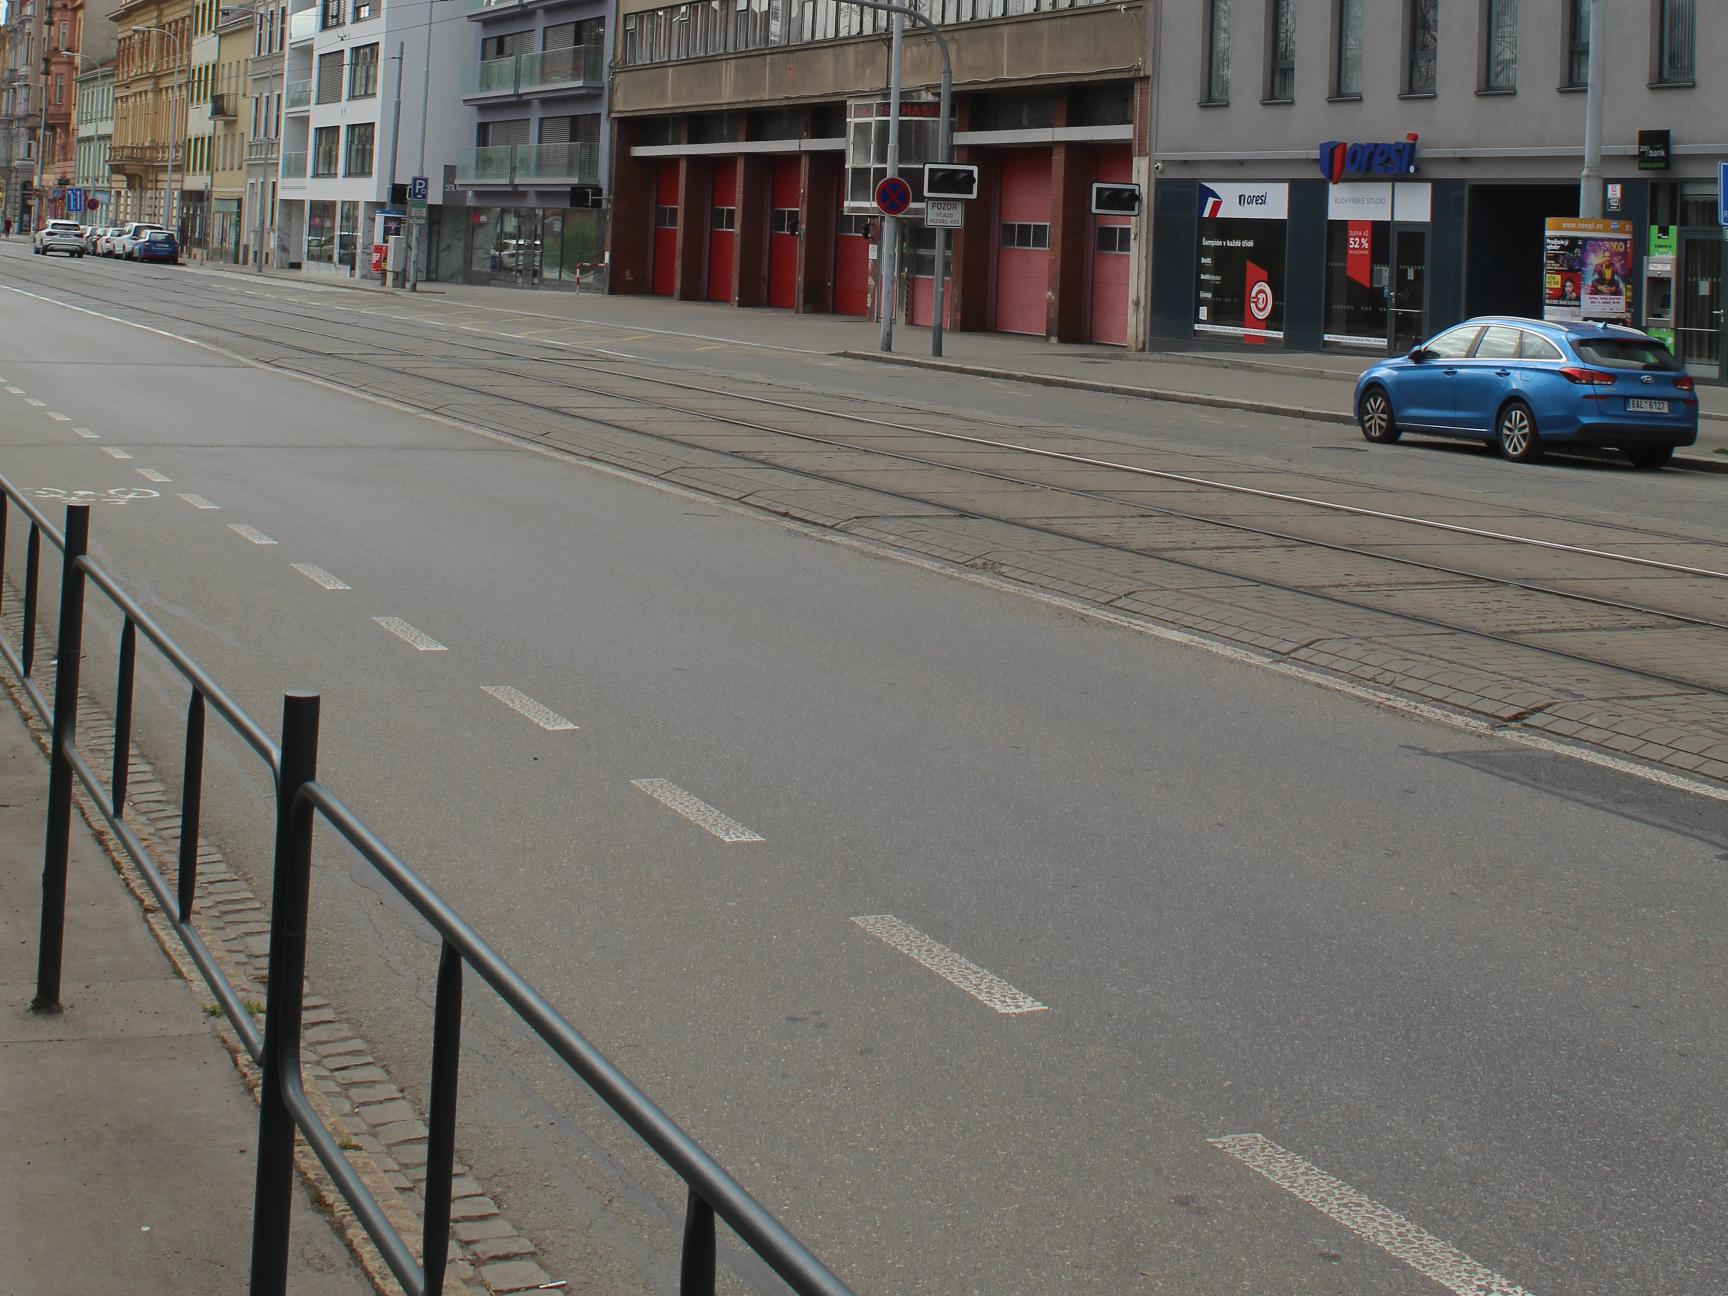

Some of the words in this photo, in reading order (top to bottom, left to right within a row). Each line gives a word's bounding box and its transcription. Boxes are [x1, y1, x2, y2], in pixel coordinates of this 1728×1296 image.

[1346, 132, 1419, 176] oresi
[1246, 191, 1268, 206] oresi
[931, 202, 958, 211] POZOR
[1349, 237, 1360, 248] 52
[1361, 238, 1369, 249] %
